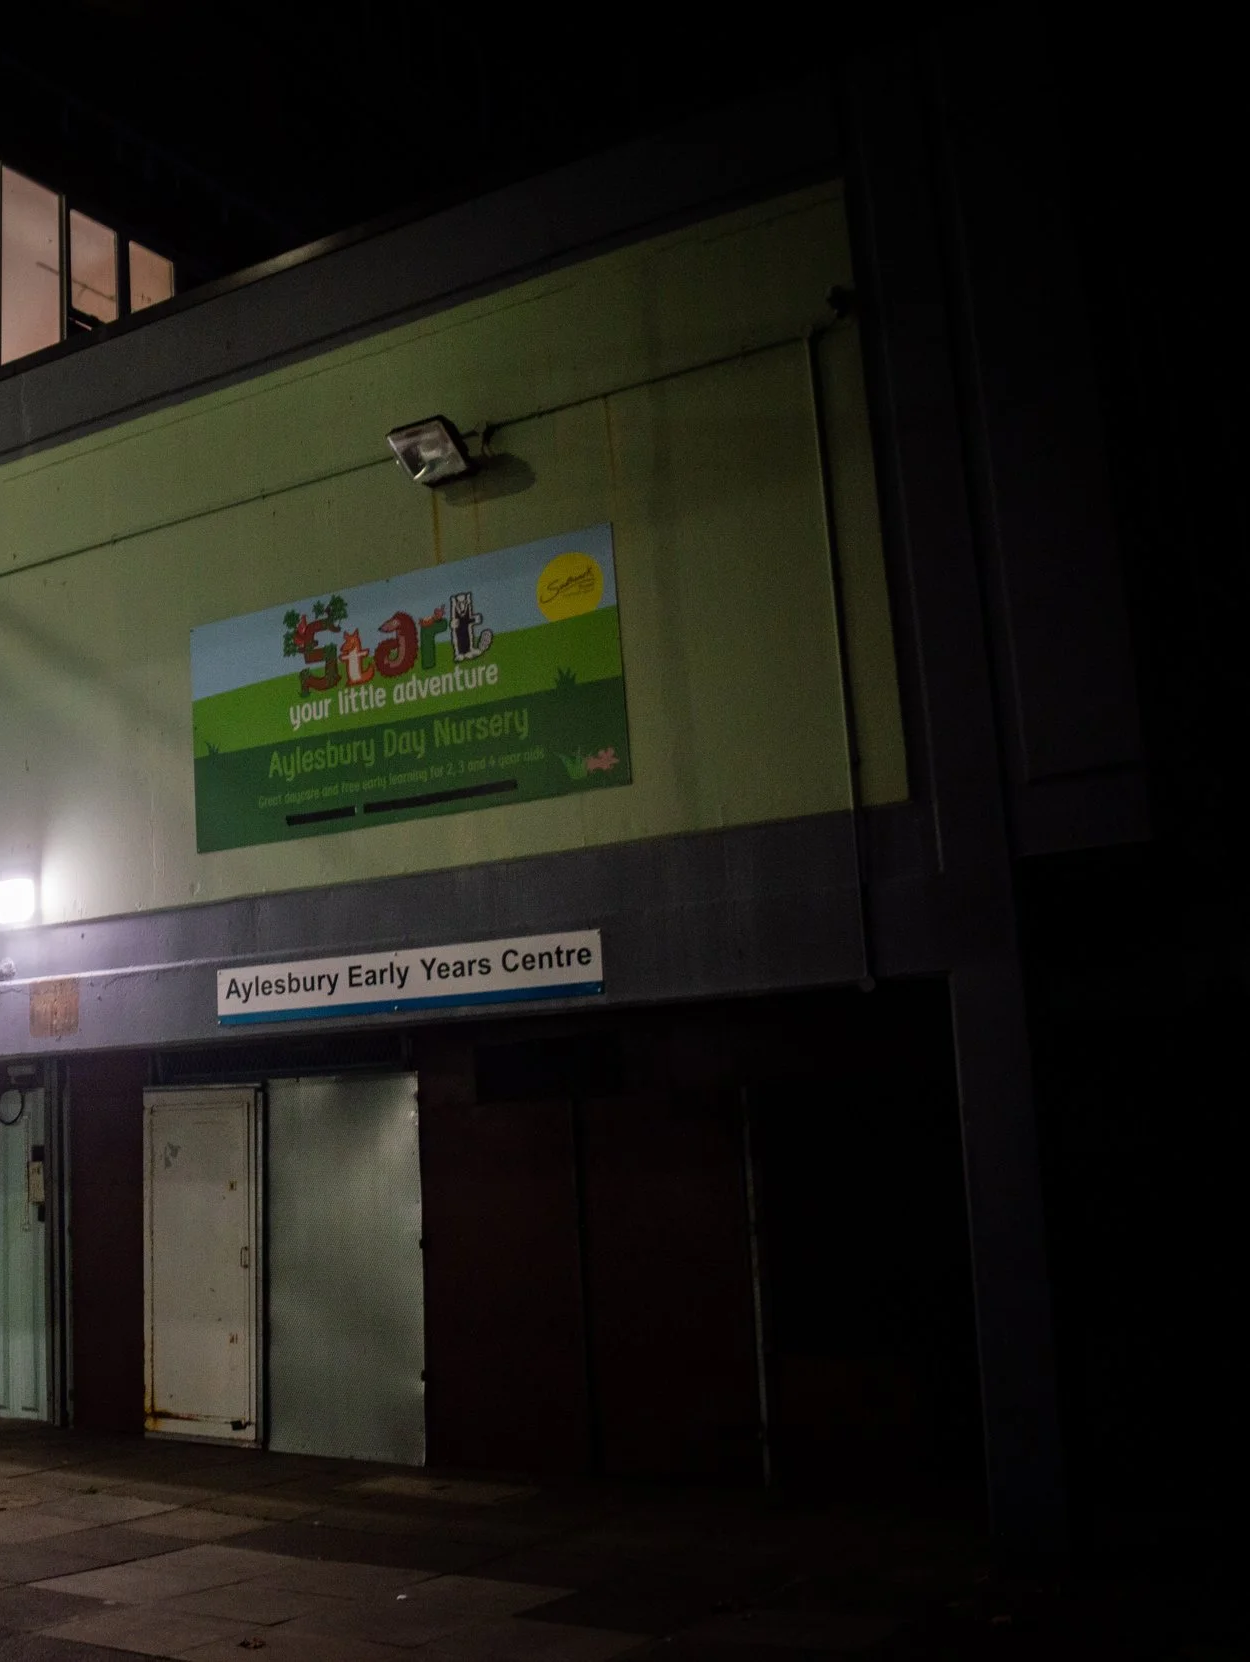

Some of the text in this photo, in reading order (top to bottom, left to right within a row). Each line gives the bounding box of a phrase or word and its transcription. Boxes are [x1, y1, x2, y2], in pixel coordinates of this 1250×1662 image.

[285, 592, 494, 697] Start
[289, 663, 499, 730] your little adventure
[268, 707, 529, 781] Aylesbury Day Nursery
[284, 788, 320, 805] daycare
[322, 784, 338, 796] and
[342, 781, 360, 793] free
[362, 775, 387, 792] early
[389, 768, 427, 785] learning
[430, 766, 444, 778] for
[458, 759, 464, 773] 3
[468, 757, 486, 772] and
[488, 756, 496, 767] 4
[498, 753, 521, 769] year
[225, 943, 592, 1004] Aylesbury Early Years Centre
